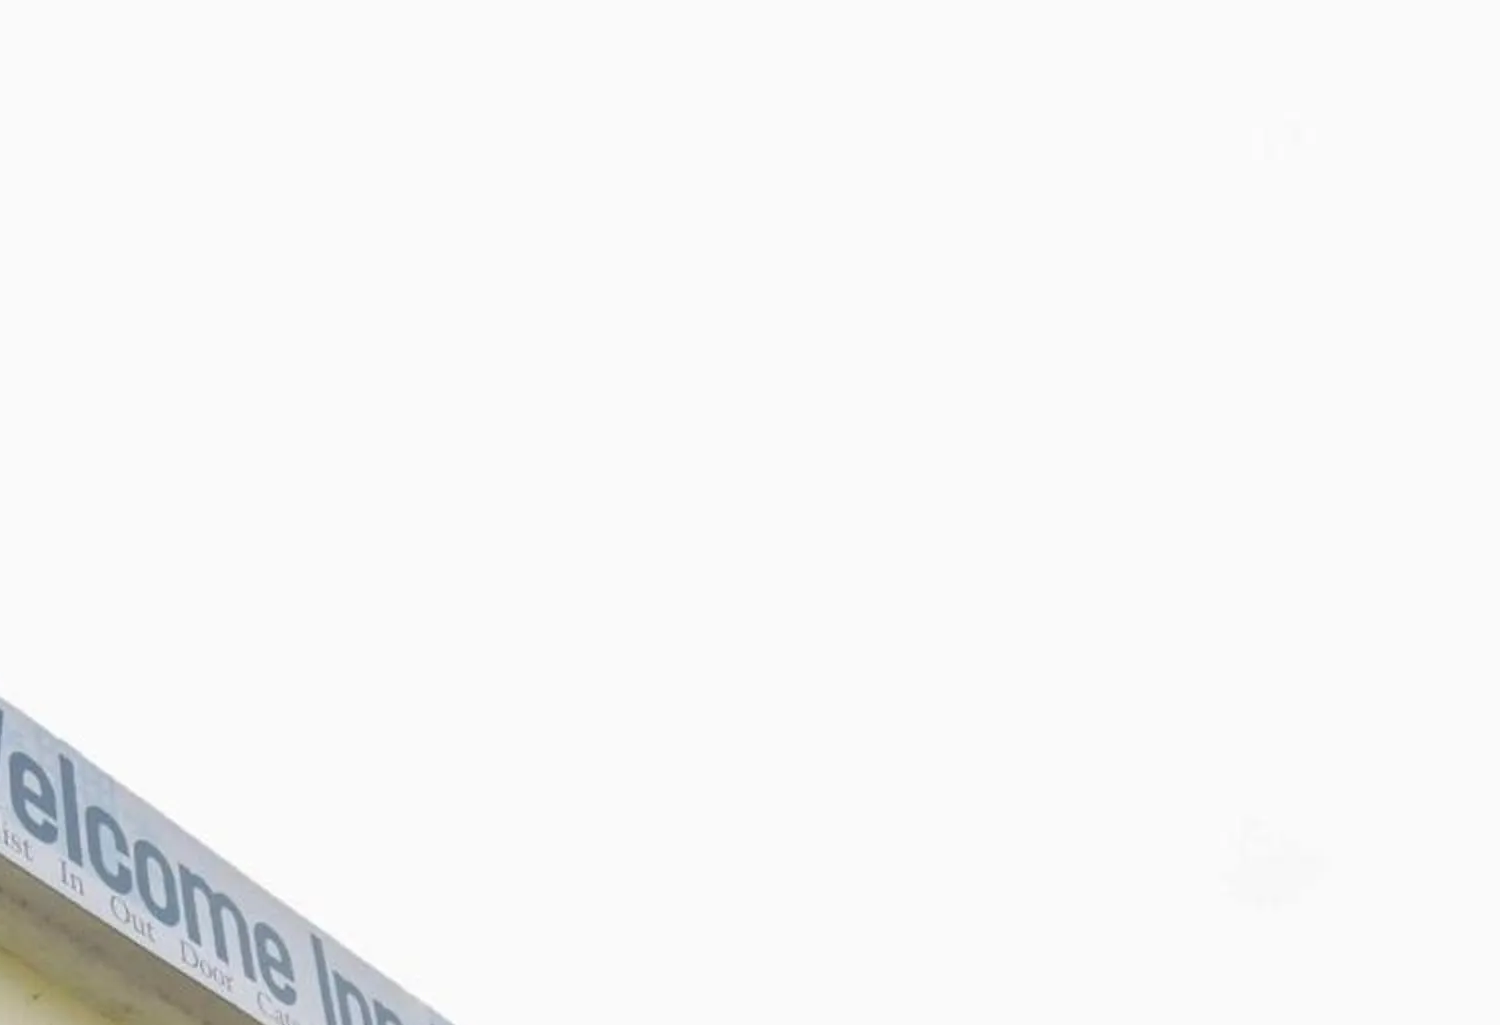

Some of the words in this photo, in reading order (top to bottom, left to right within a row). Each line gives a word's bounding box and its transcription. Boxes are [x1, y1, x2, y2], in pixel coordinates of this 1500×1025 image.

[60, 859, 86, 897] In
[109, 894, 157, 944] Out
[180, 940, 235, 992] Door
